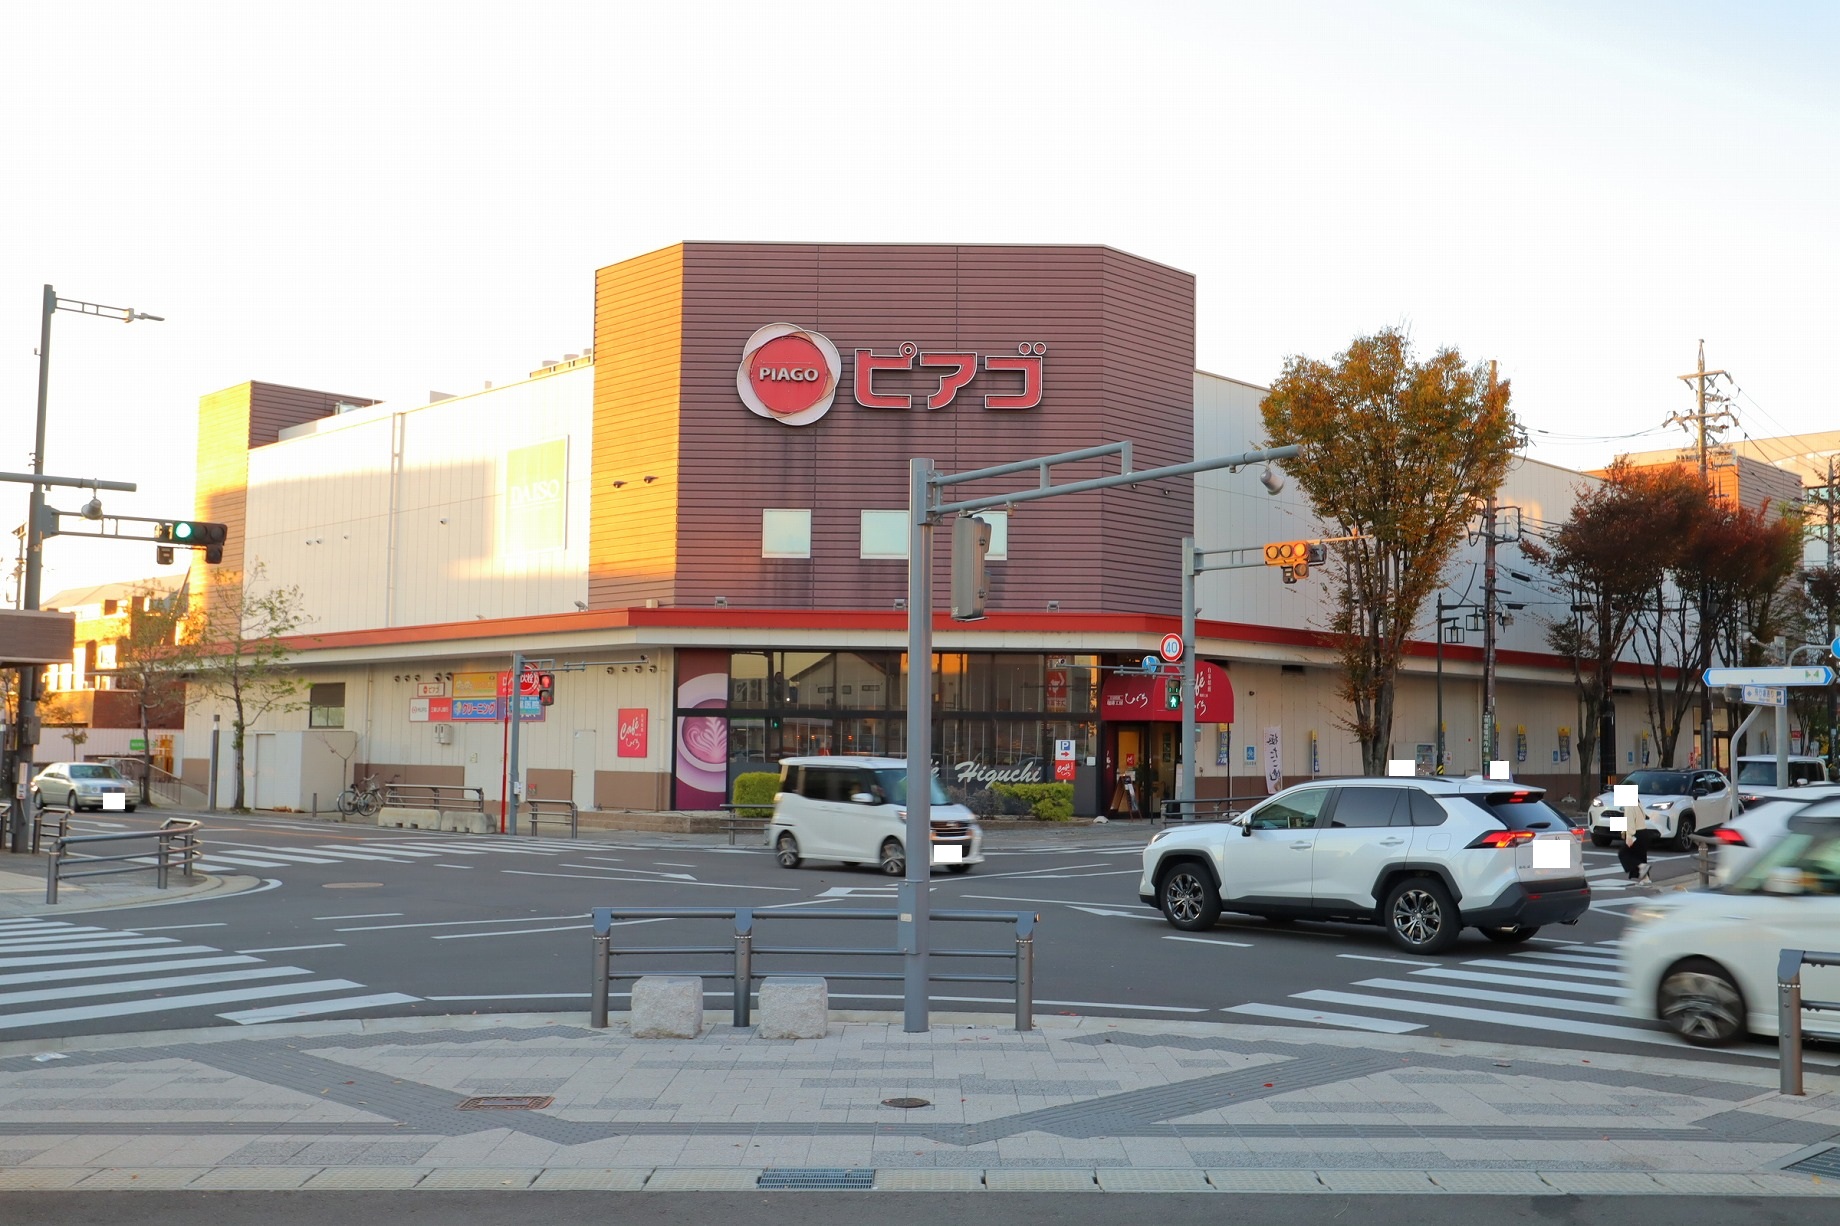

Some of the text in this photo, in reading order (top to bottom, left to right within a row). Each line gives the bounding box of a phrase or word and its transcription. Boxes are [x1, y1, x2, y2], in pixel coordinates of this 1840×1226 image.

[758, 366, 819, 383] PIAGO
[854, 341, 1047, 410] ピアゴ
[511, 479, 560, 505] DAISO
[1165, 641, 1178, 653] 40
[462, 702, 496, 715] クリーニング
[620, 716, 640, 740] Café
[1062, 742, 1069, 750] P
[955, 761, 1042, 790] Higuchi
